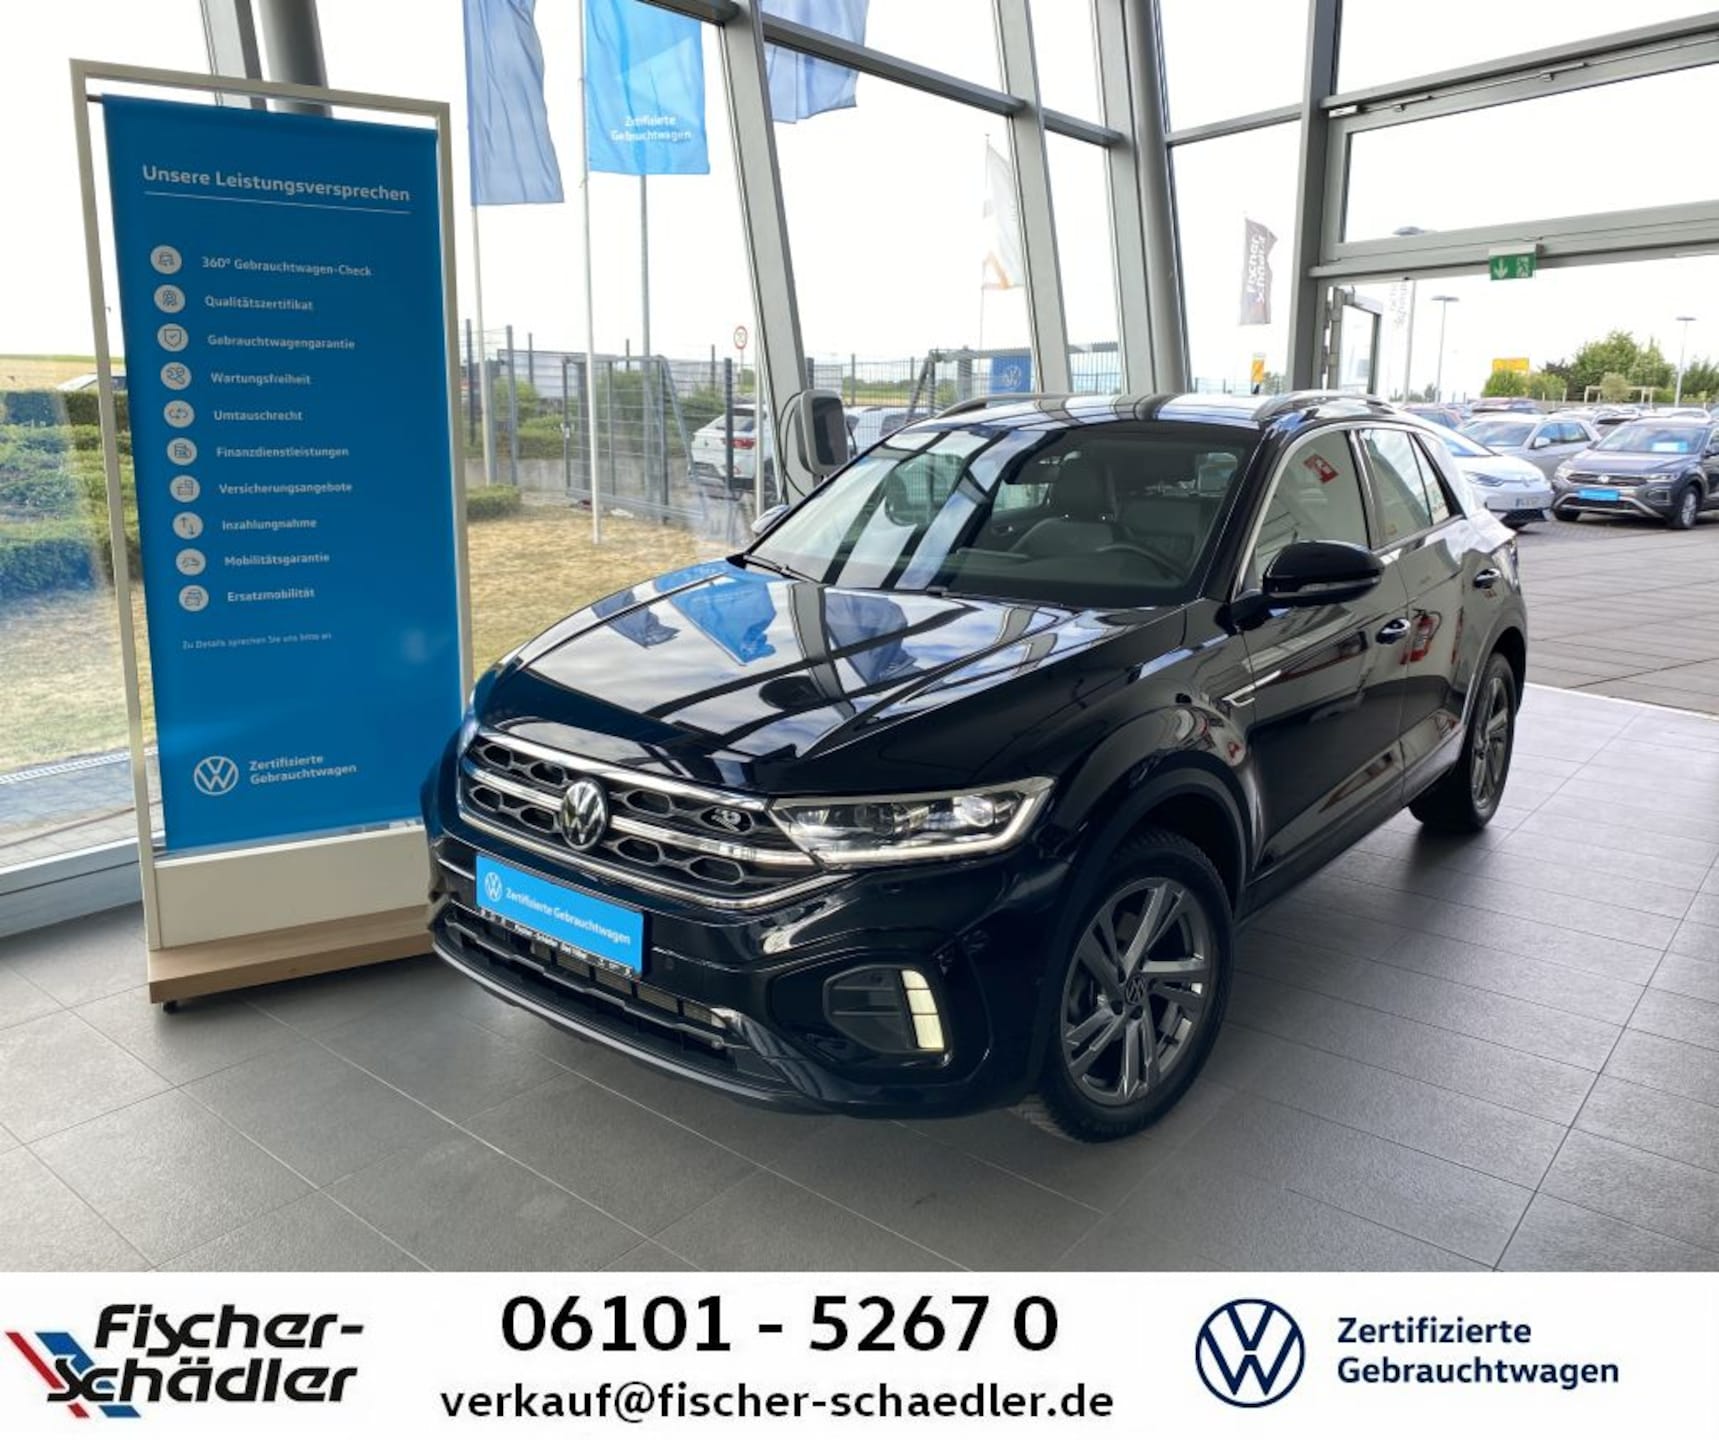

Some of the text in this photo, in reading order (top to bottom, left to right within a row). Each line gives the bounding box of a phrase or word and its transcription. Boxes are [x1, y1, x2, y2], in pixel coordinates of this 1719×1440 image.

[142, 164, 411, 202] Unsere Leistungsversprechen
[234, 259, 372, 277] Gebrauchtwagen-Check
[204, 294, 314, 311] Qualitätszertifikat
[207, 334, 356, 351] Gebrauchtwagengarantie
[210, 371, 311, 387] Wartungsfreiheit
[213, 409, 303, 422] Umtauschrecht
[216, 446, 349, 459] Finanzdienstleistungen
[219, 482, 353, 495] Versicherungsangebote
[222, 518, 317, 531] Inzahlungnahme
[224, 553, 330, 567] Mobilitätsgarantie
[227, 587, 315, 602] Ersatzmobilität
[249, 755, 324, 771] Zertifizierte
[250, 763, 357, 785] Gebrauchtwagen
[553, 906, 631, 945] Gebrauchtwagen
